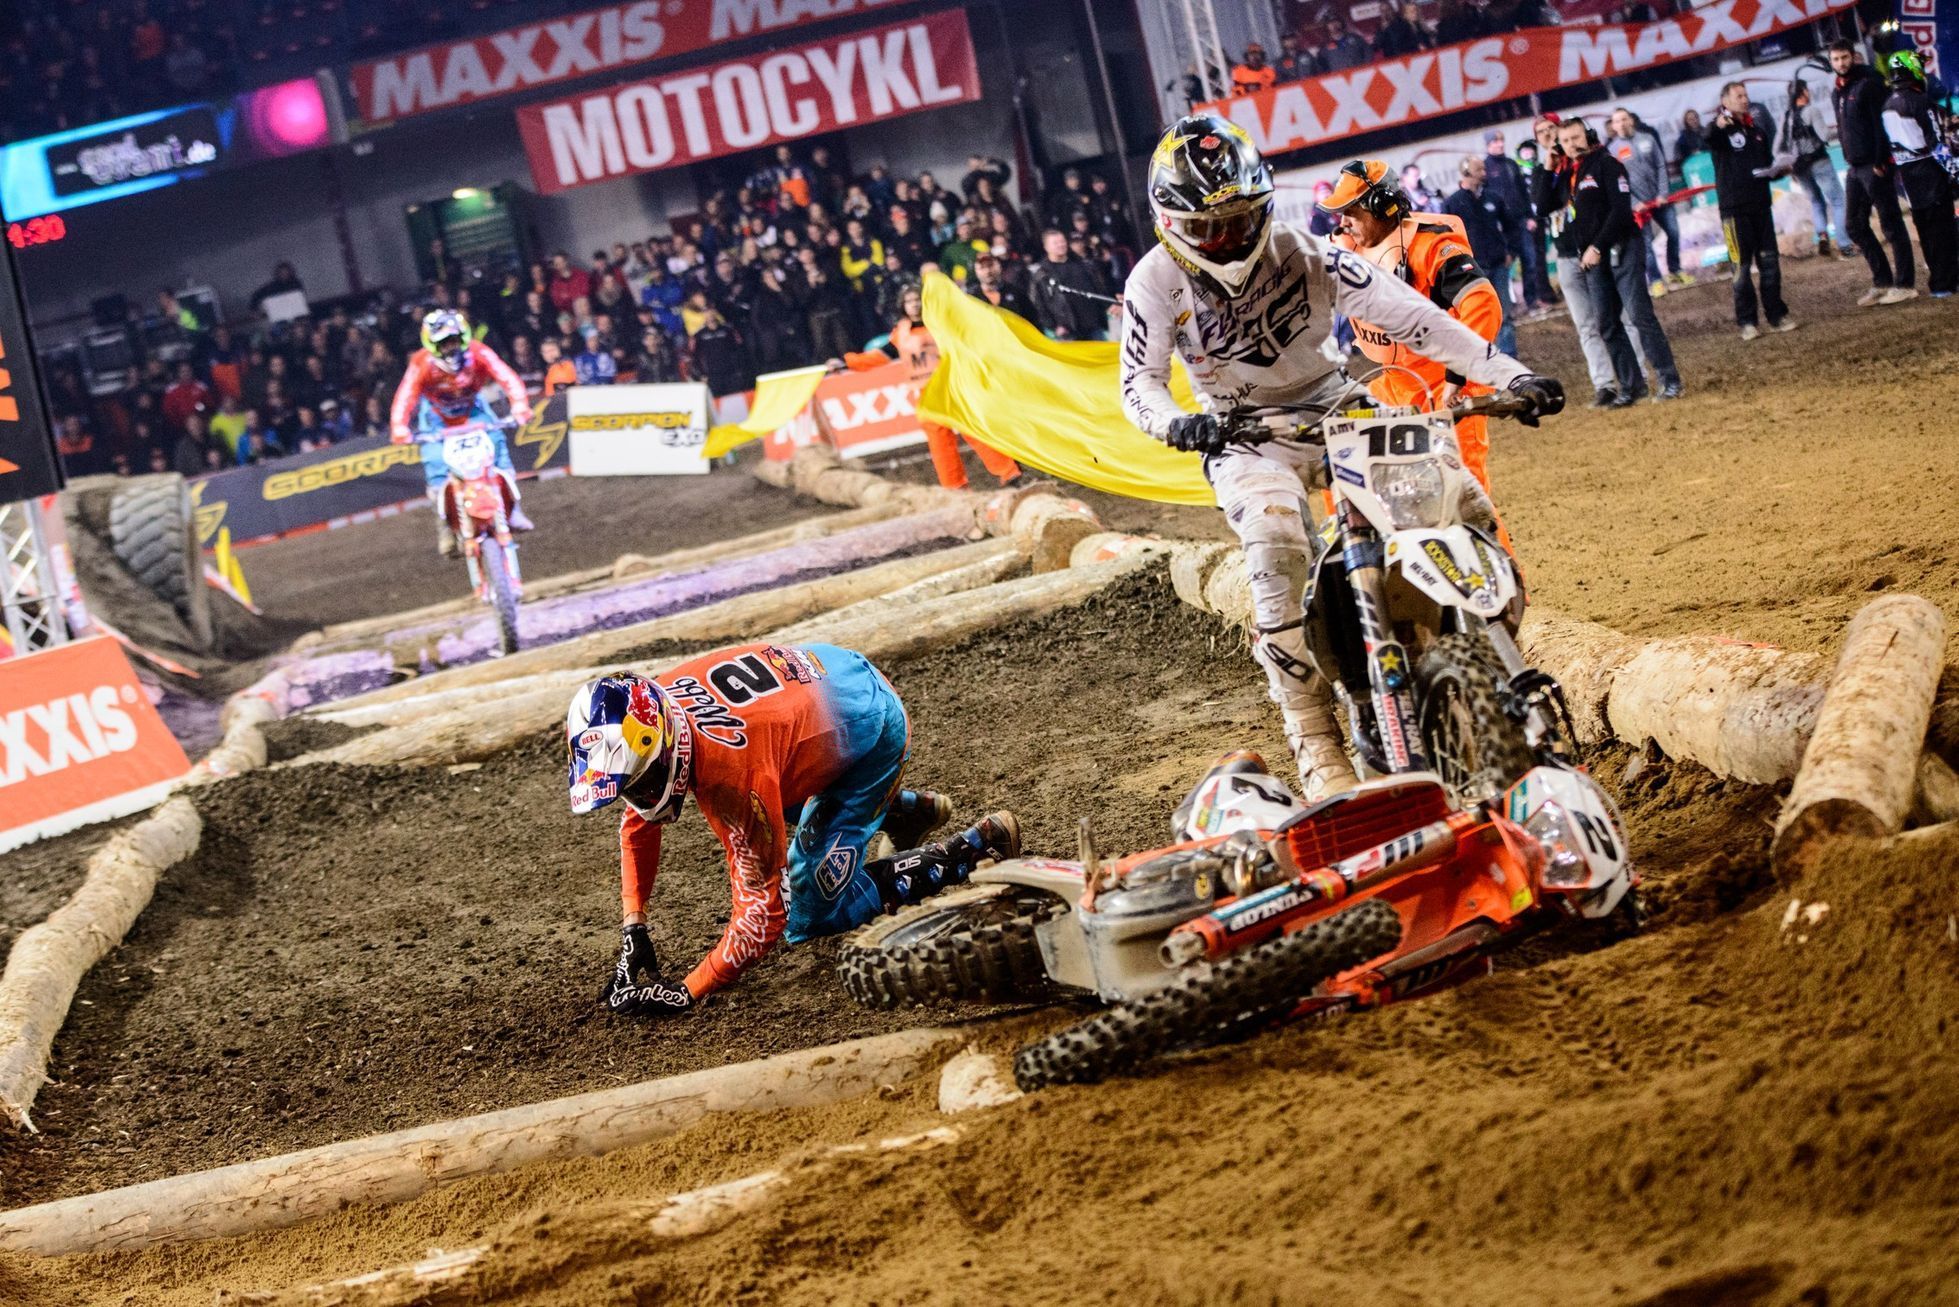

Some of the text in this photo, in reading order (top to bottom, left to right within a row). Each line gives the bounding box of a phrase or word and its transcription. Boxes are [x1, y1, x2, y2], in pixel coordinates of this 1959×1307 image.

[543, 25, 963, 186] MOTOCYKL
[1359, 424, 1430, 458] 10
[706, 651, 785, 708] 2
[664, 676, 749, 749] Webb
[581, 734, 600, 746] BELL
[571, 781, 617, 808] Red Bull
